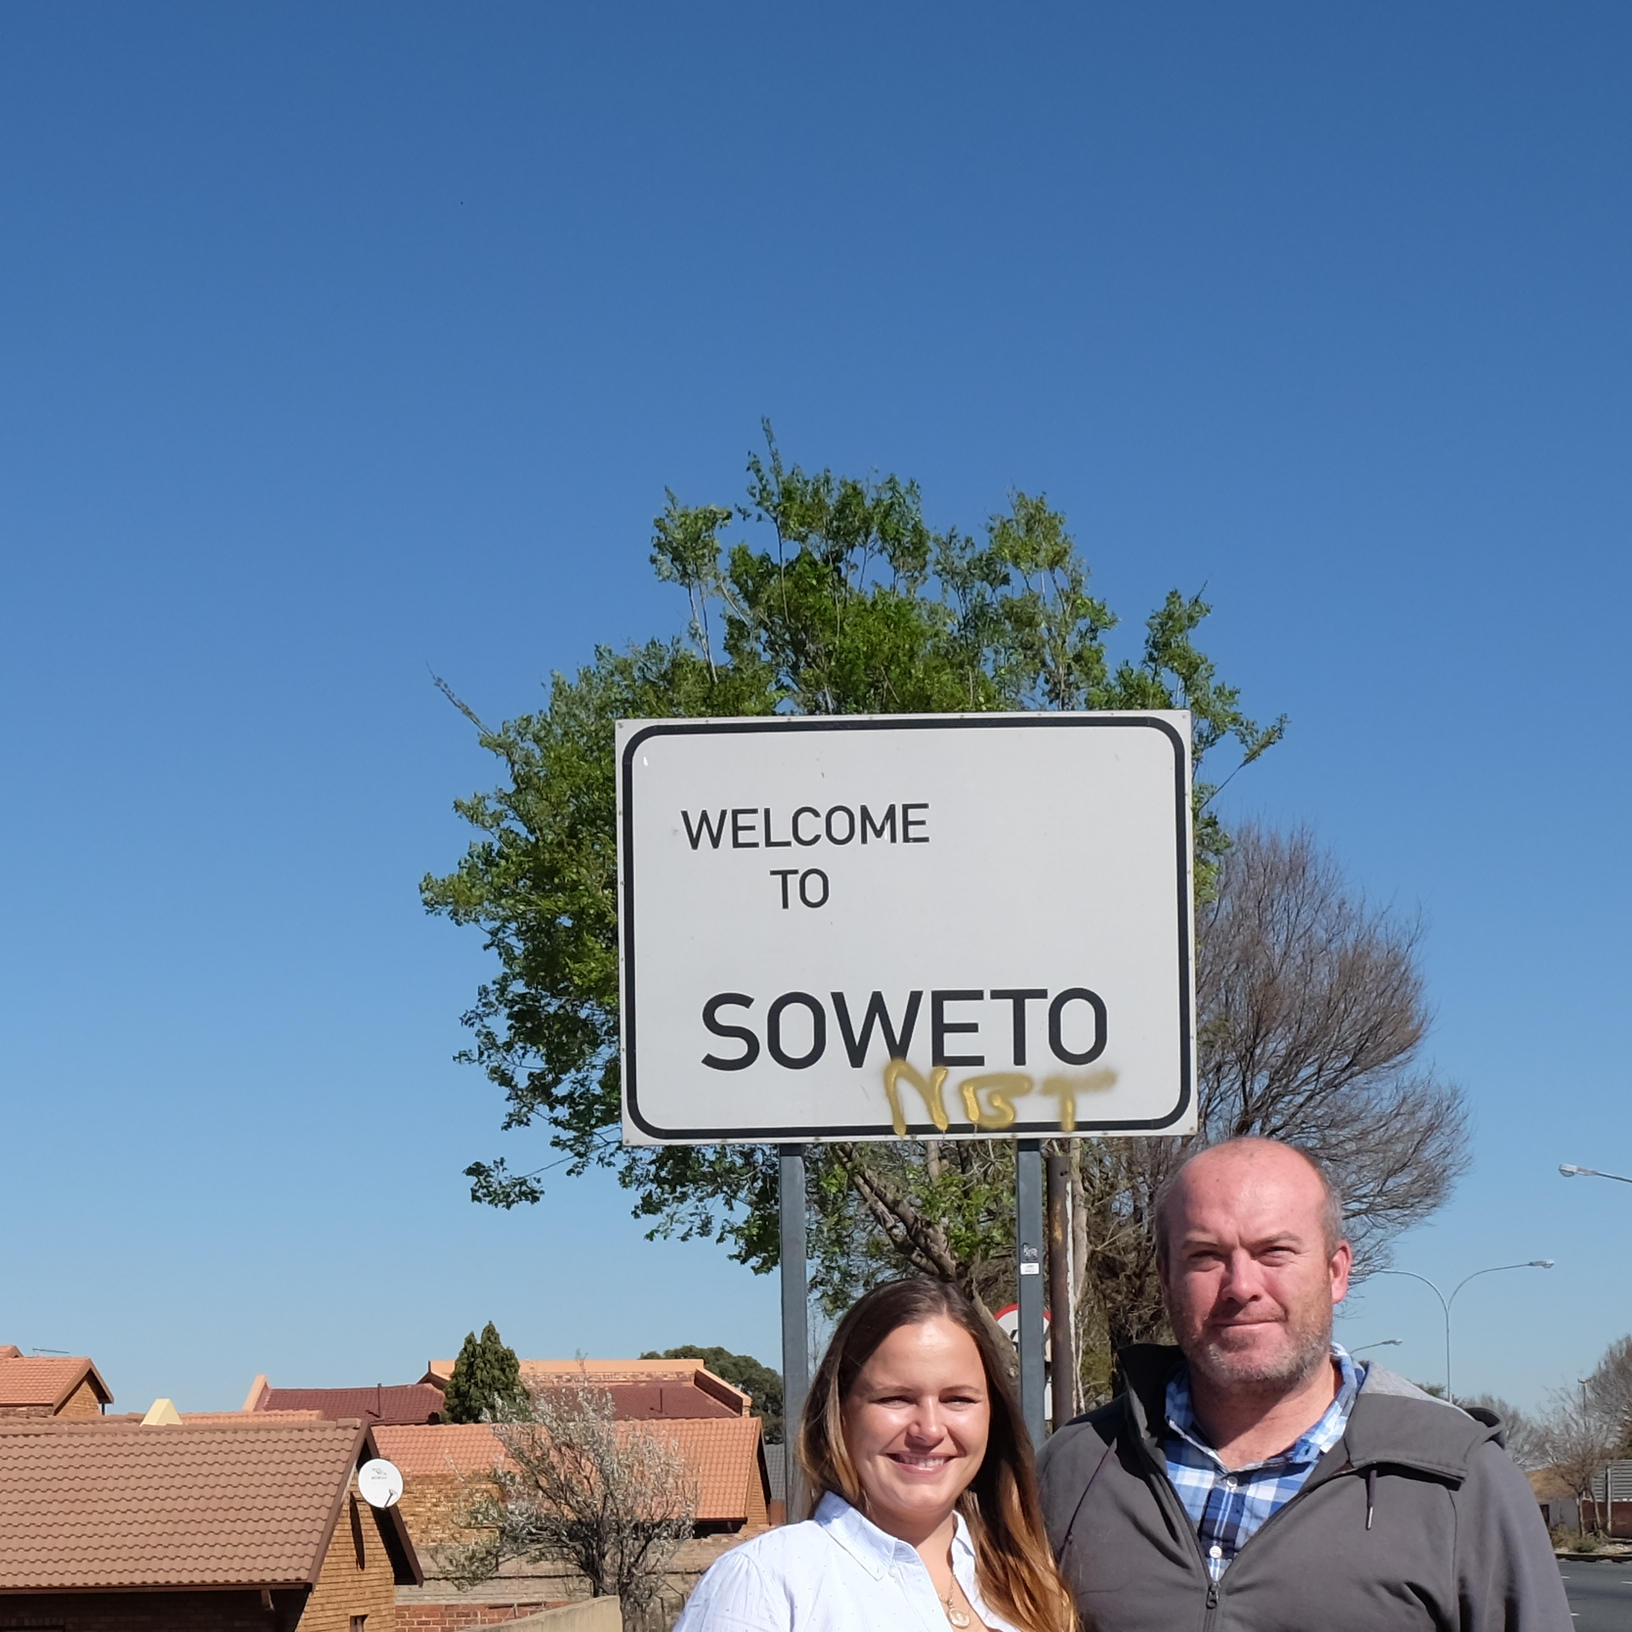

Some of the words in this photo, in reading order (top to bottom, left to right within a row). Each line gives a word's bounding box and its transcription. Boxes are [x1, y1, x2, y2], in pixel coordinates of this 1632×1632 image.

[680, 803, 930, 851] WELCOME
[769, 868, 830, 910] TO
[701, 987, 1108, 1071] SOWETO
